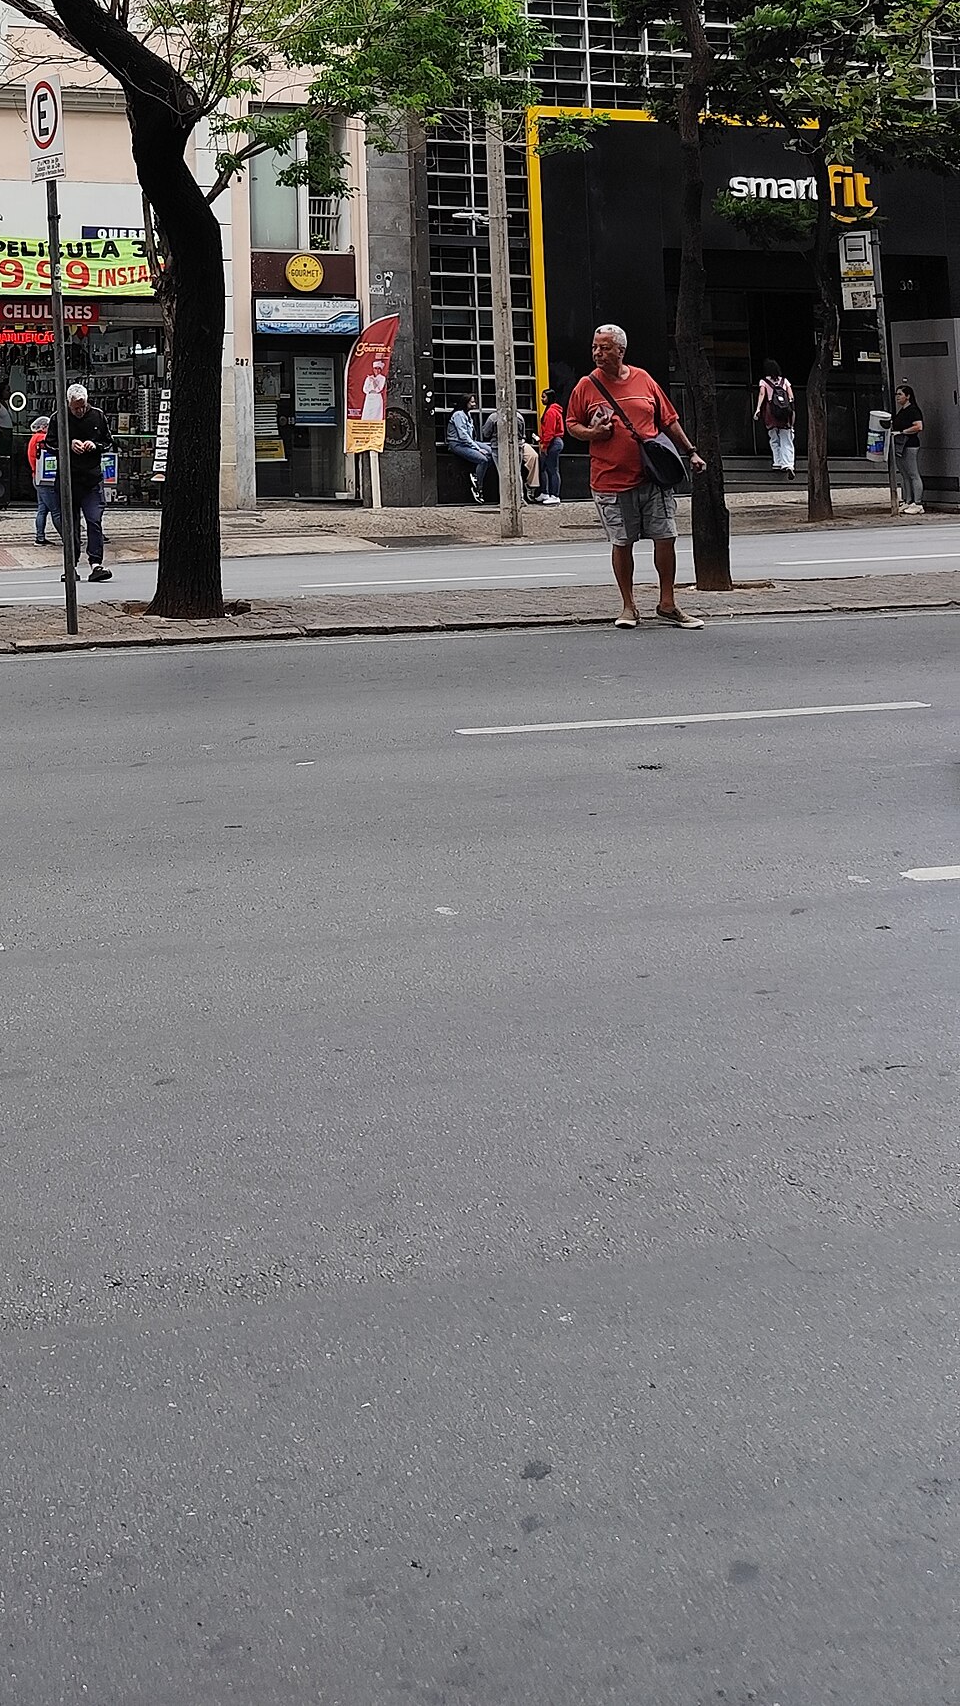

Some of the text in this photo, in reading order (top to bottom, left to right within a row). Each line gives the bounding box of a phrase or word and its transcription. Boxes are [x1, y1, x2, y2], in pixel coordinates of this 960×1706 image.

[37, 93, 50, 137] E
[729, 164, 874, 208] smart fit
[291, 268, 320, 278] GOURMET
[3, 304, 93, 320] CELULRES
